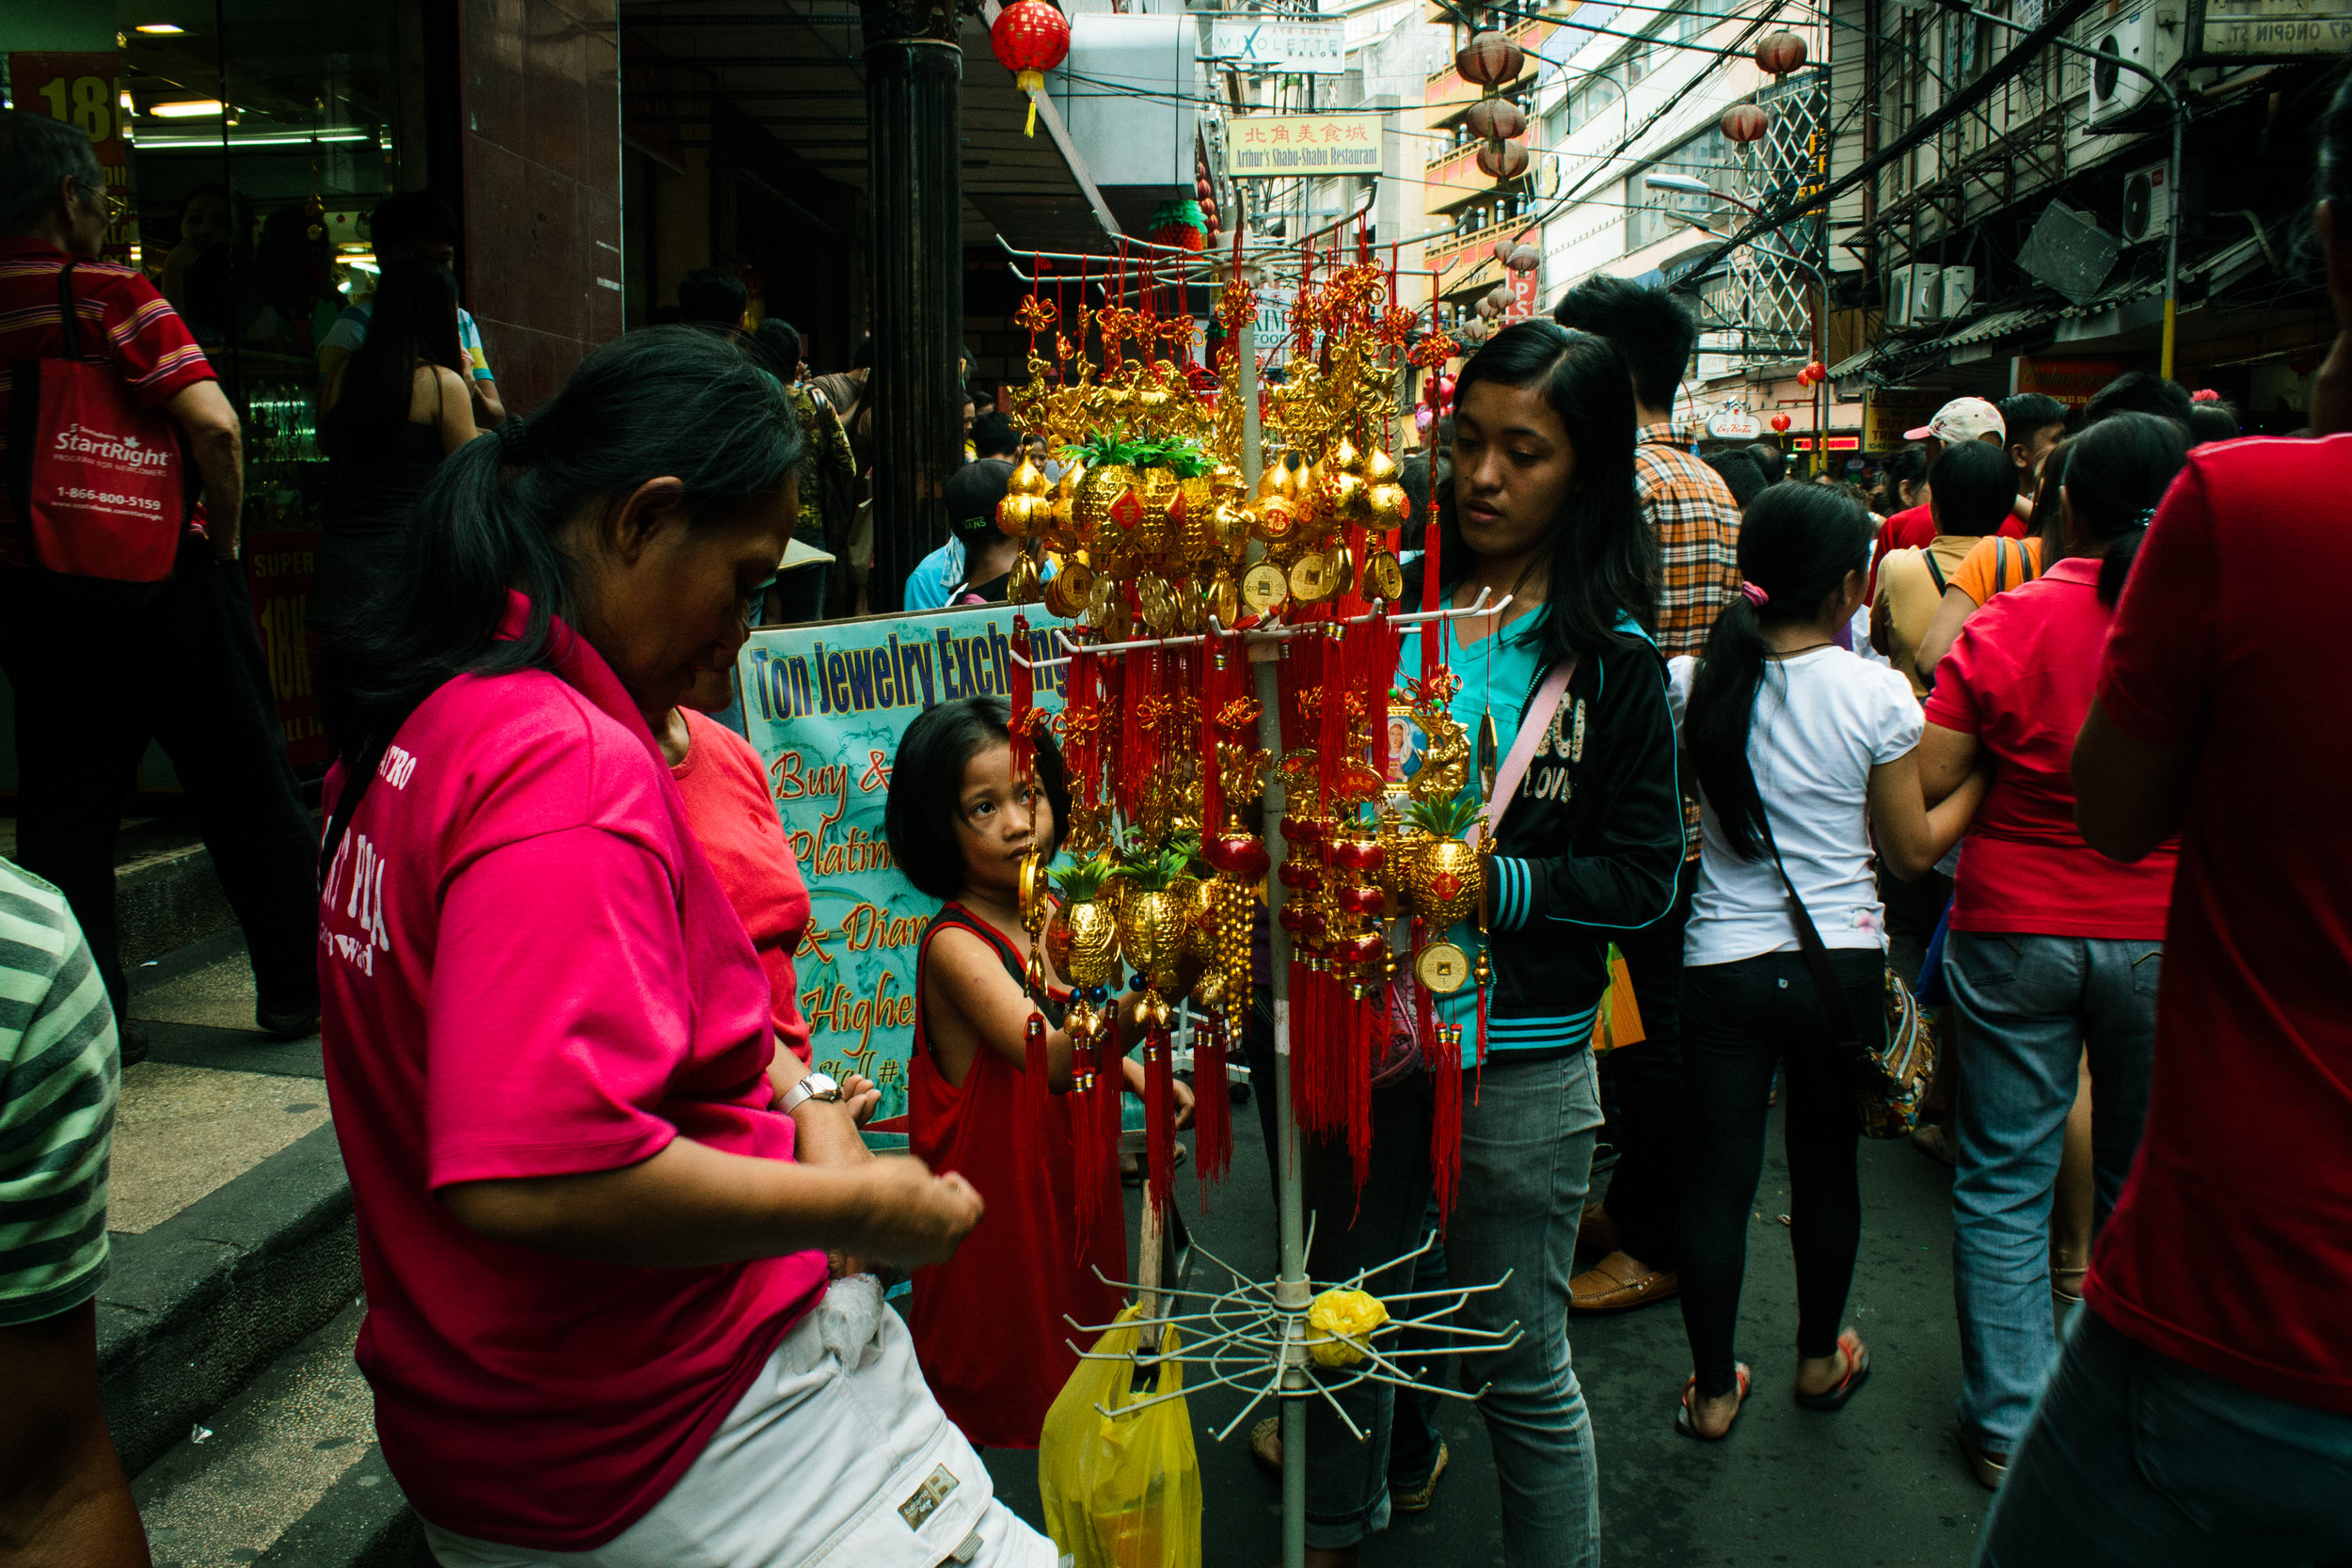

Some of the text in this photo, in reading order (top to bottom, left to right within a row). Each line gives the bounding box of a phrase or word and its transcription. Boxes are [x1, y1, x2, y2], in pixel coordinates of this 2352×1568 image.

[39, 75, 123, 143] 18
[1245, 123, 1369, 143] 北角美食城
[1236, 146, 1377, 167] Arthur's Shabu-Shabu Restaurant
[1516, 282, 1529, 324] PS
[55, 432, 168, 467] StartRight
[96, 460, 113, 469] FOR
[115, 464, 167, 477] NEWCOMERS
[56, 486, 162, 511] 1-866-800-5159
[1267, 512, 1286, 531] 福
[253, 550, 315, 578] SUPER
[750, 621, 1069, 721] Ton Jewelry Exchng
[770, 750, 893, 824] Buy &
[787, 816, 901, 877] Platin
[795, 917, 834, 964] &
[801, 971, 916, 1058] Highe
